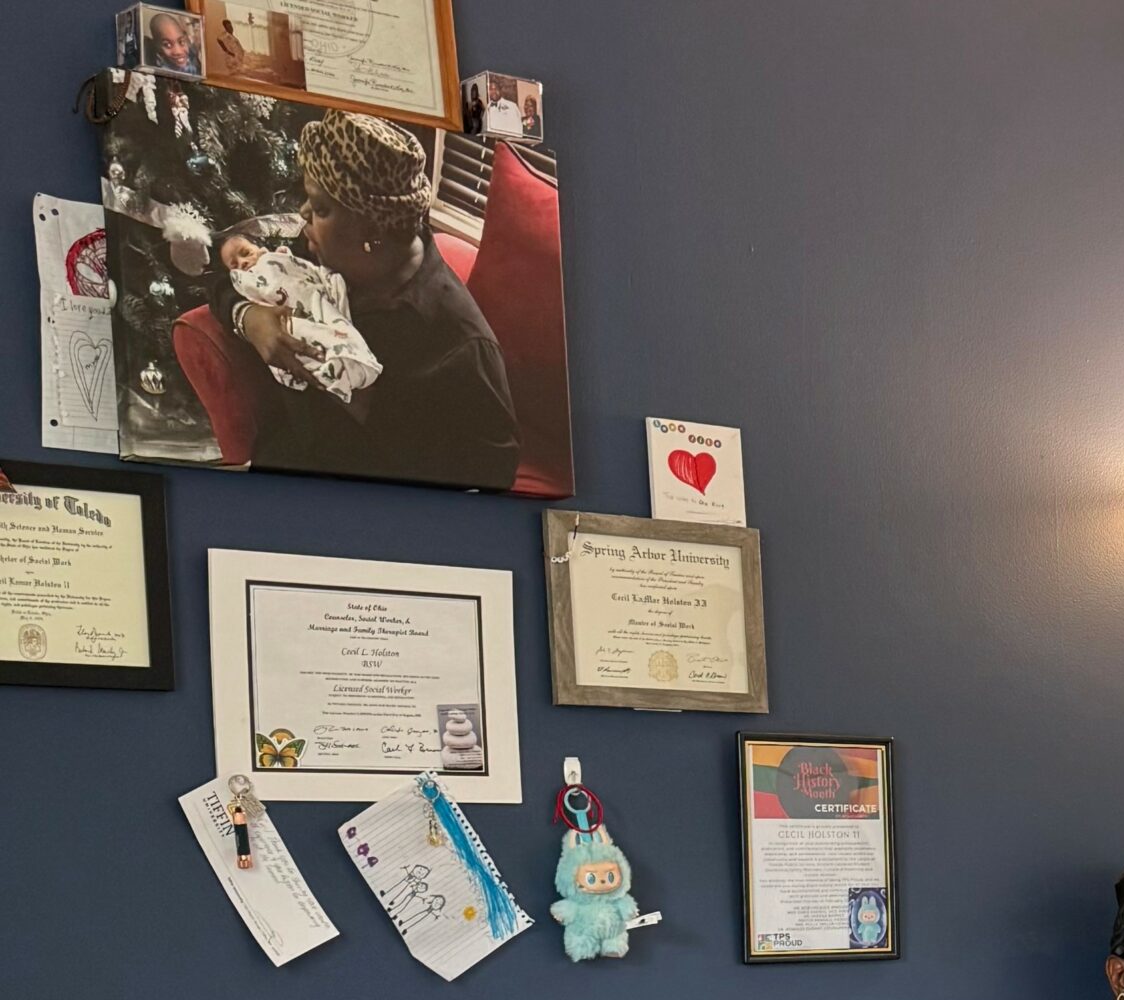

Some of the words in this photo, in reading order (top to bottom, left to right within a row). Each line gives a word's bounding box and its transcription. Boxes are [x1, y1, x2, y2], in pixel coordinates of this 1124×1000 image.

[45, 495, 60, 510] of
[63, 495, 112, 527] Toledo
[51, 525, 77, 534] Human
[19, 555, 26, 564] of
[27, 555, 51, 565] Social
[52, 558, 72, 567] Work
[581, 541, 626, 560] Spring
[630, 545, 666, 561] Arbor
[670, 548, 730, 569] University
[611, 592, 630, 603] Cecil
[632, 593, 660, 605] LaMar
[662, 595, 692, 607] Holston
[347, 603, 363, 611] State
[365, 604, 371, 612] of
[358, 615, 377, 623] Social
[658, 620, 677, 628] Social
[678, 622, 695, 630] Work
[307, 624, 338, 634] Marriage
[353, 626, 376, 635] Family
[377, 627, 407, 637] Therapist
[408, 628, 429, 637] Board
[341, 647, 360, 656] Cecil
[371, 648, 400, 657] Holston
[333, 684, 364, 693] Licensed
[364, 685, 385, 694] Social
[386, 686, 412, 696] Worker
[799, 762, 834, 777] Black
[793, 773, 840, 791] History
[207, 790, 236, 836] TIFFIN
[814, 803, 877, 813] CERTIFICATE
[778, 830, 805, 839] CECIL
[808, 830, 849, 839] HOLSTON
[773, 939, 803, 947] PROUD
